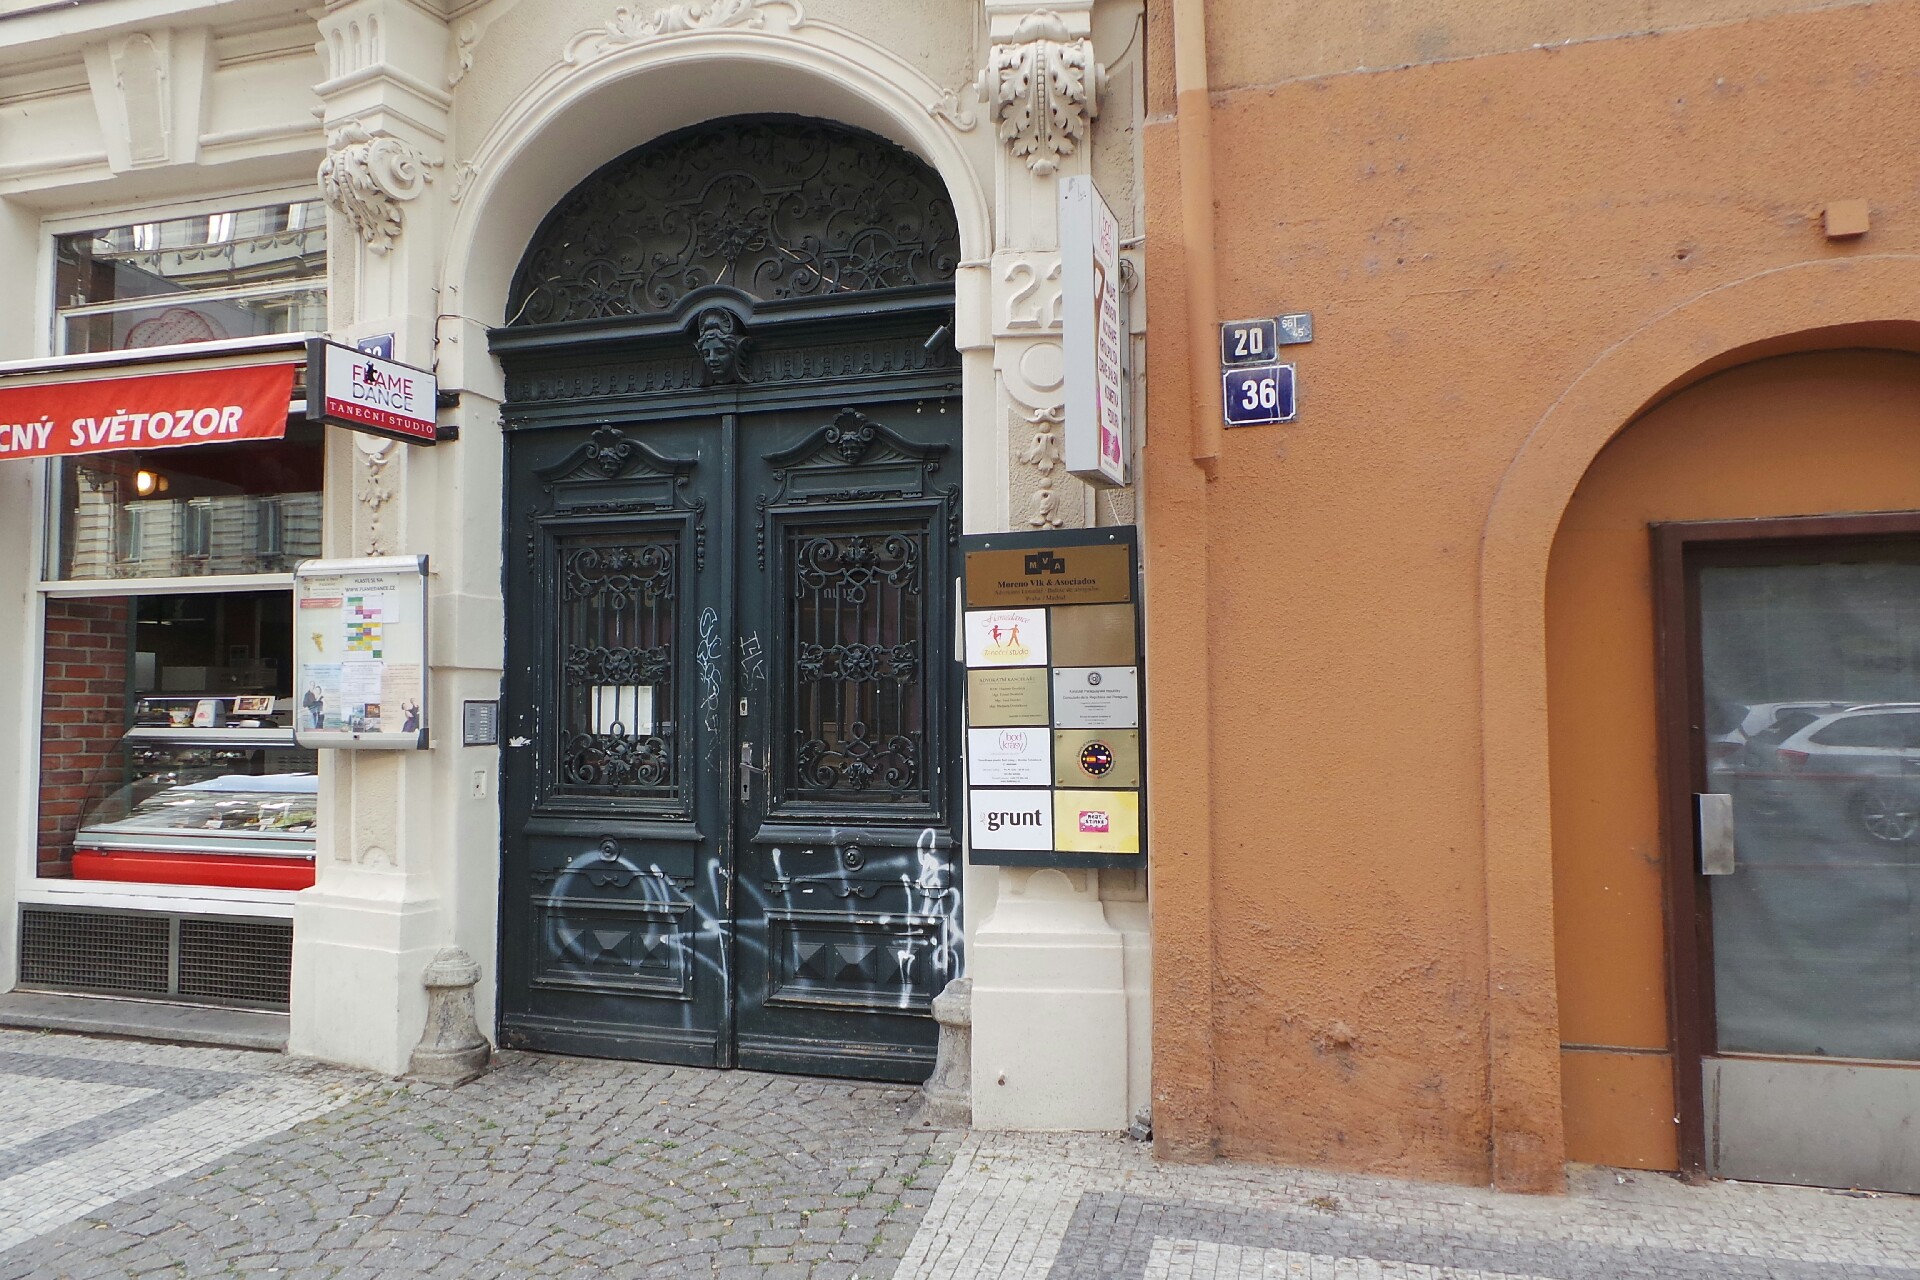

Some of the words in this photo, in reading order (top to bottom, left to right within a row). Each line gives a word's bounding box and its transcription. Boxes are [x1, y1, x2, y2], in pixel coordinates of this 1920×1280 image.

[1234, 327, 1263, 356] 20
[352, 363, 414, 397] FLAME
[1241, 378, 1276, 410] 36
[352, 382, 414, 412] DANCE
[69, 405, 244, 447] SVĚTOZOR
[329, 401, 385, 423] TANEČNÍ
[388, 415, 433, 434] STUDIO
[1030, 579, 1044, 587] Vlk
[1055, 577, 1096, 586] Asociados
[1009, 648, 1029, 656] studio
[987, 809, 1043, 831] grunt
